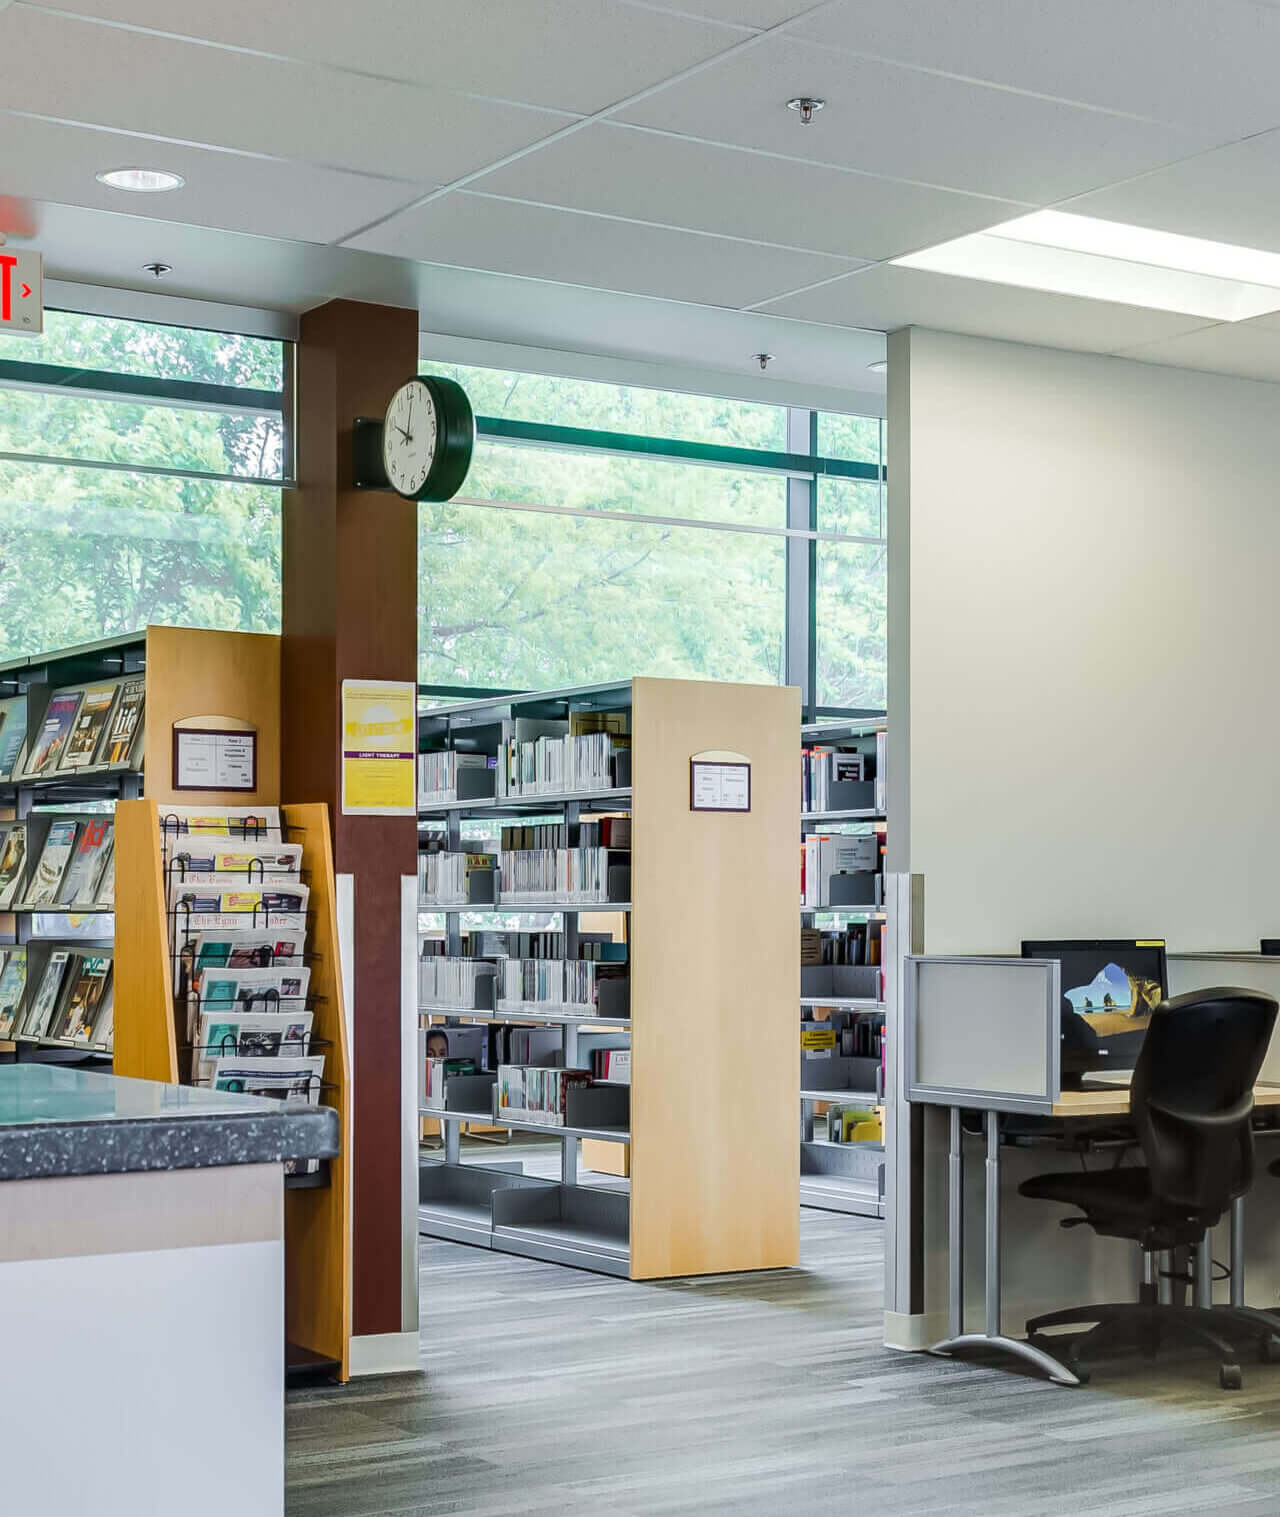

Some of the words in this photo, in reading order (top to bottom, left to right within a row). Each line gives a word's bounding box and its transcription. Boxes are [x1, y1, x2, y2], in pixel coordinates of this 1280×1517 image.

[406, 384, 415, 401] 12
[426, 399, 432, 416] 2
[400, 474, 406, 489] 7
[420, 465, 426, 482] 5
[410, 475, 416, 491] 6
